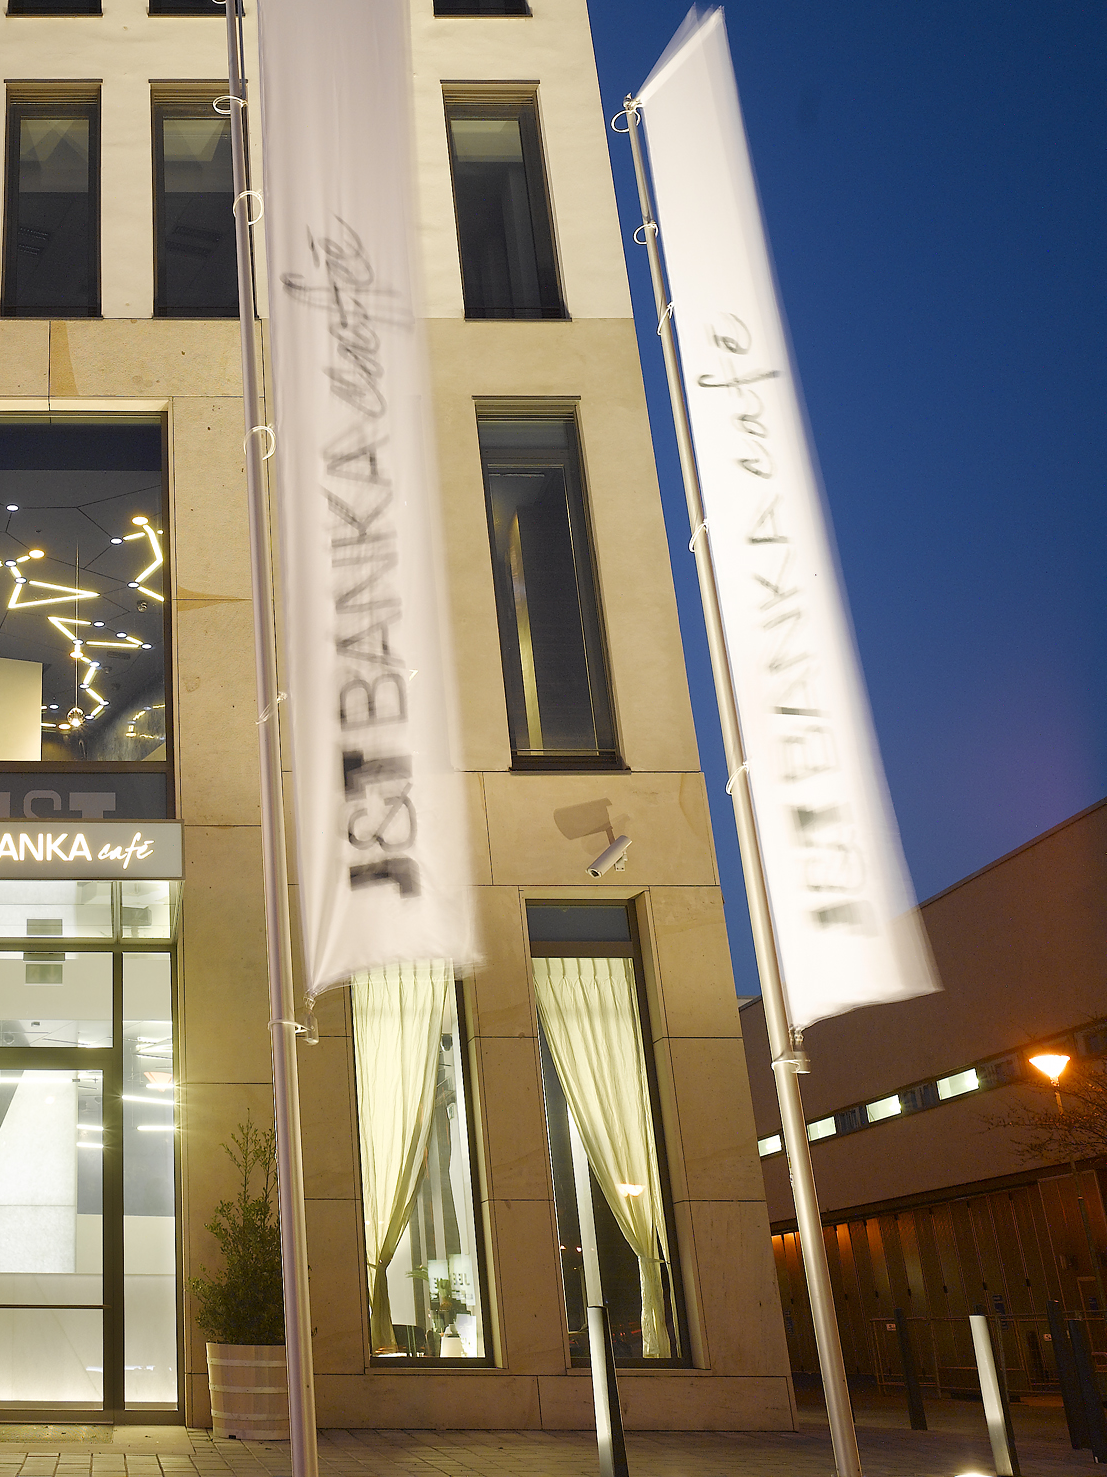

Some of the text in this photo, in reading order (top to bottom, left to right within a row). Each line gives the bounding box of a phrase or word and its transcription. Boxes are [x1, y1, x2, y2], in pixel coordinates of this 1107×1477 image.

[322, 435, 408, 732] BANKA
[97, 832, 155, 869] café
[342, 749, 422, 899] J&T
